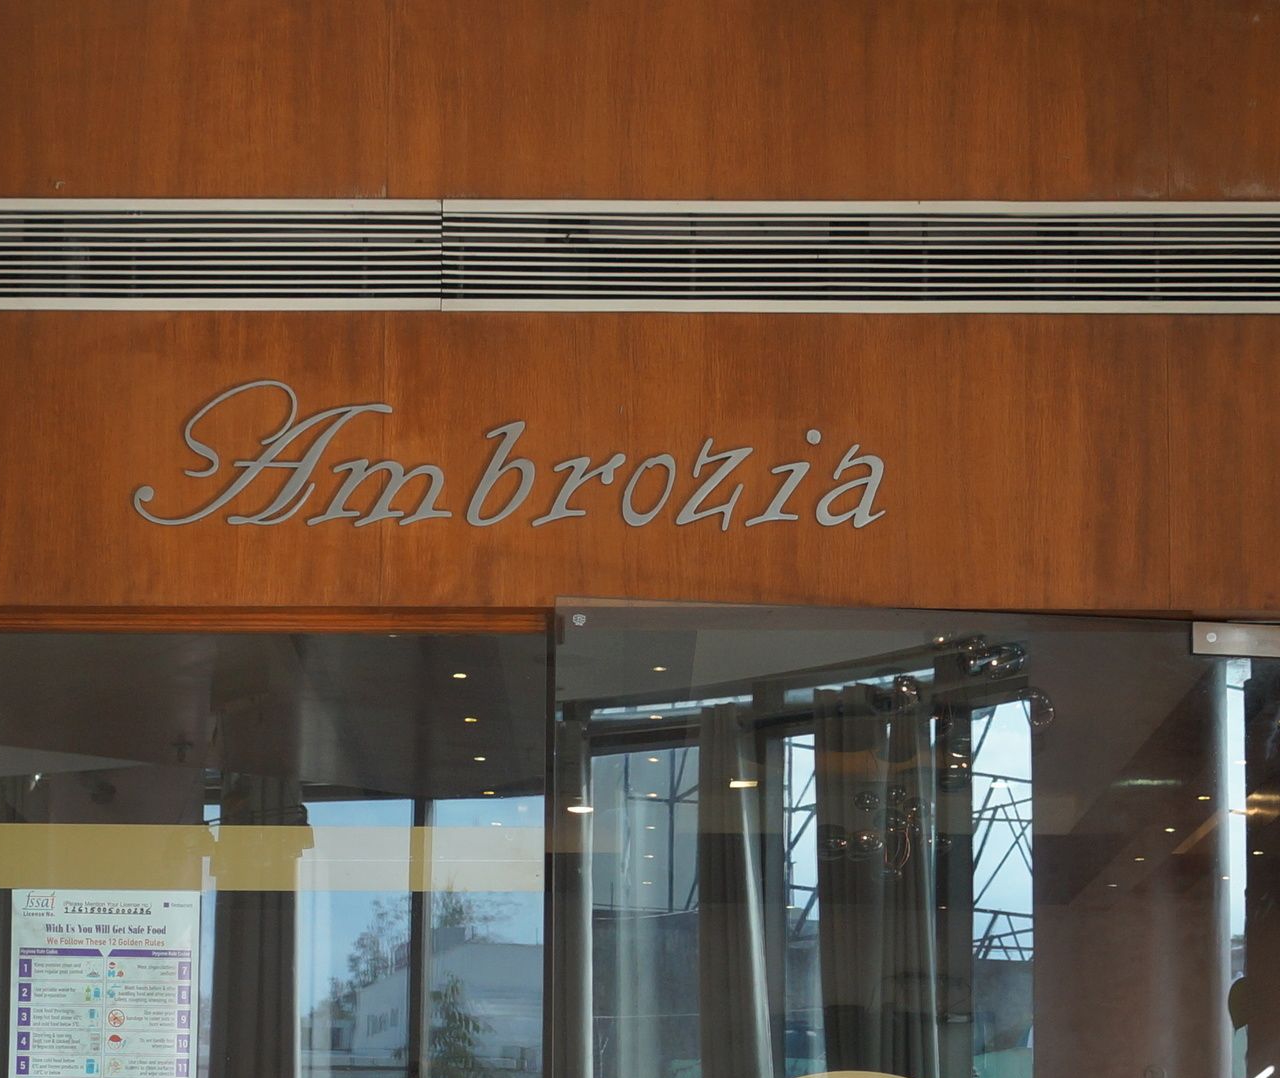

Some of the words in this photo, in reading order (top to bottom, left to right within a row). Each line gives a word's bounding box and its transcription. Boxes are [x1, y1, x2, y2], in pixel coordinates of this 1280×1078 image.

[133, 379, 887, 533] Ambrozia
[45, 923, 64, 934] With
[77, 924, 93, 935] You
[95, 923, 110, 935] Will
[112, 925, 125, 935] Get
[127, 924, 144, 935] Safe
[147, 925, 166, 935] Food
[46, 937, 59, 945] We
[60, 937, 83, 945] Follow
[85, 937, 107, 945] These
[118, 938, 144, 947] Golden
[145, 939, 165, 947] Rules
[23, 963, 28, 973] 1
[182, 966, 188, 975] 7
[22, 988, 28, 997] 2
[181, 991, 187, 1000] 8
[21, 1012, 27, 1021] 3
[180, 1015, 187, 1024] 9
[20, 1037, 27, 1046] 4
[178, 1039, 188, 1048] 10
[20, 1061, 26, 1070] 5
[178, 1063, 187, 1072] 11
